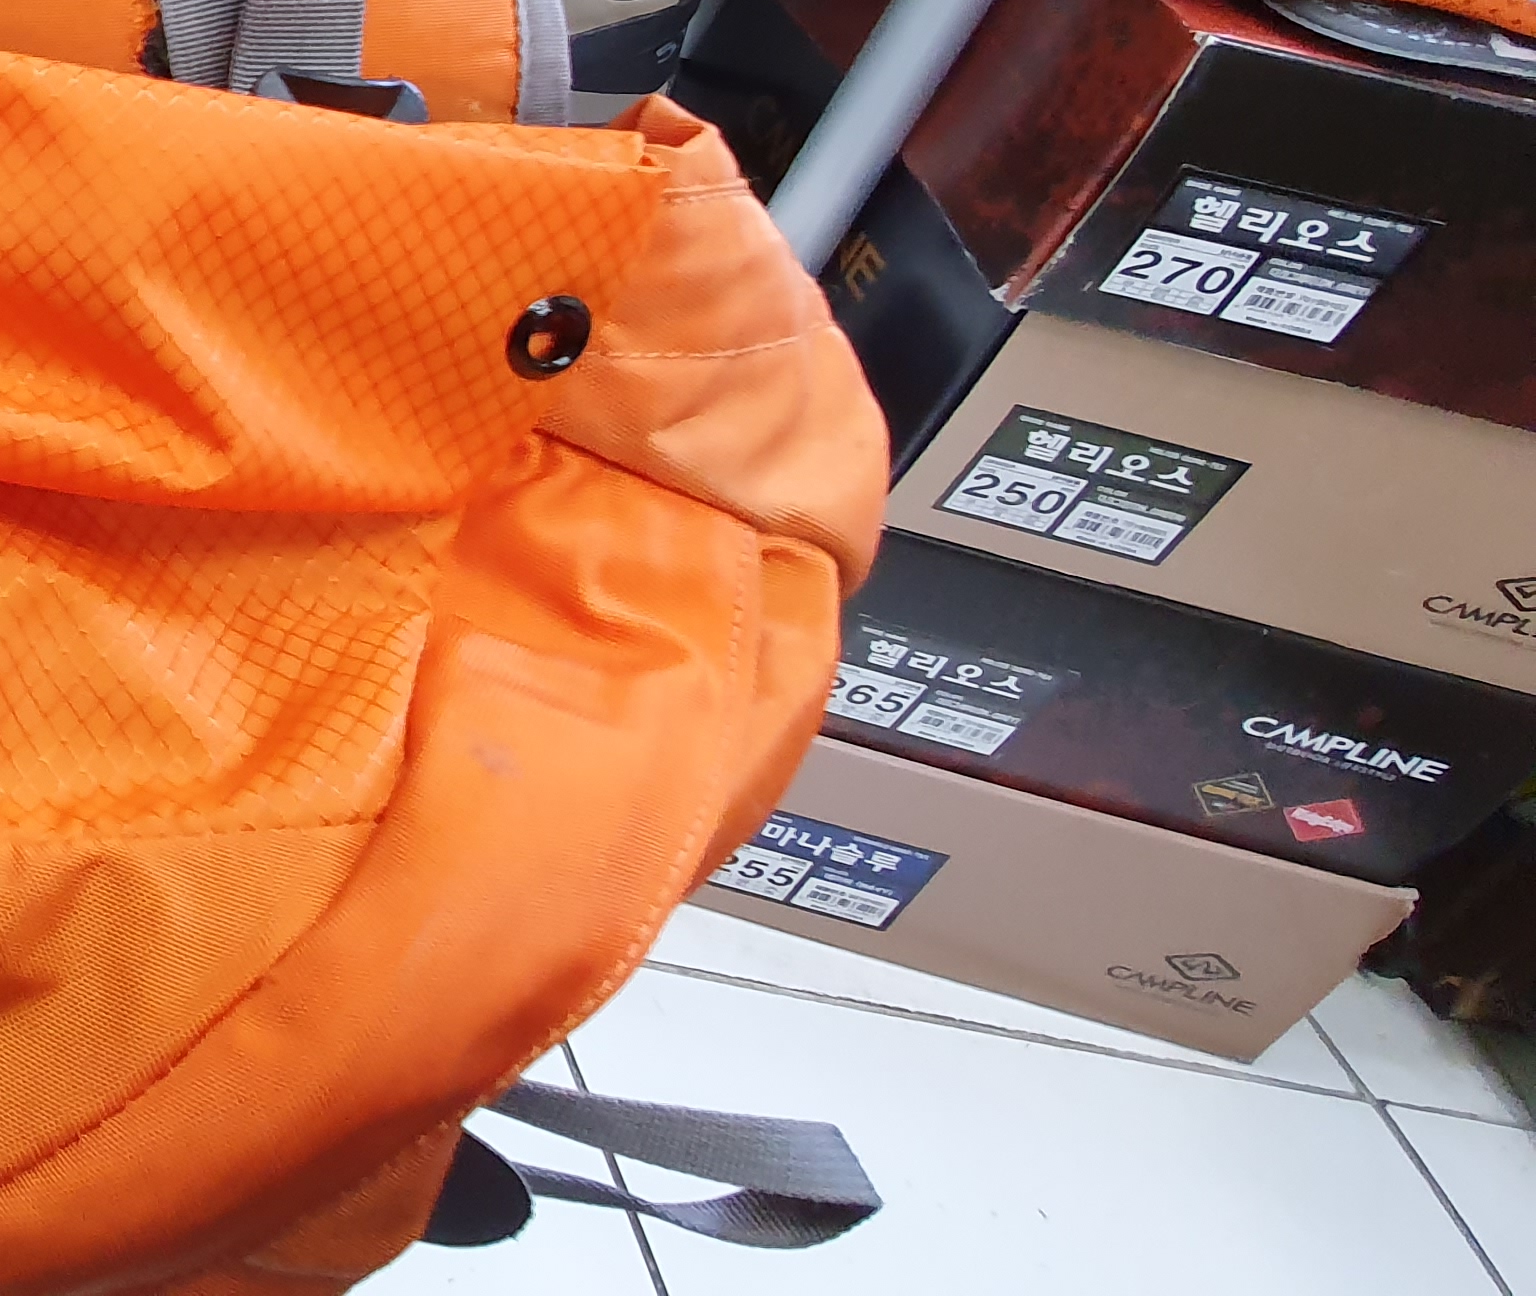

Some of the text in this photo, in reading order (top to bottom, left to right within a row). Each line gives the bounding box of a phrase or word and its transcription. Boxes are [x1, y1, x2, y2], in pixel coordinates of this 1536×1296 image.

[1189, 195, 1378, 263] 헬리오스
[1117, 250, 1235, 295] 270
[1024, 429, 1194, 494] 헬리오스
[961, 473, 1068, 515] 250
[1422, 594, 1536, 638] CAMPL
[867, 639, 1024, 700] 헬리오스
[1241, 716, 1451, 783] CAMPLINE
[760, 821, 902, 873] 마나슬루
[1106, 965, 1257, 1016] CAMPLINE
